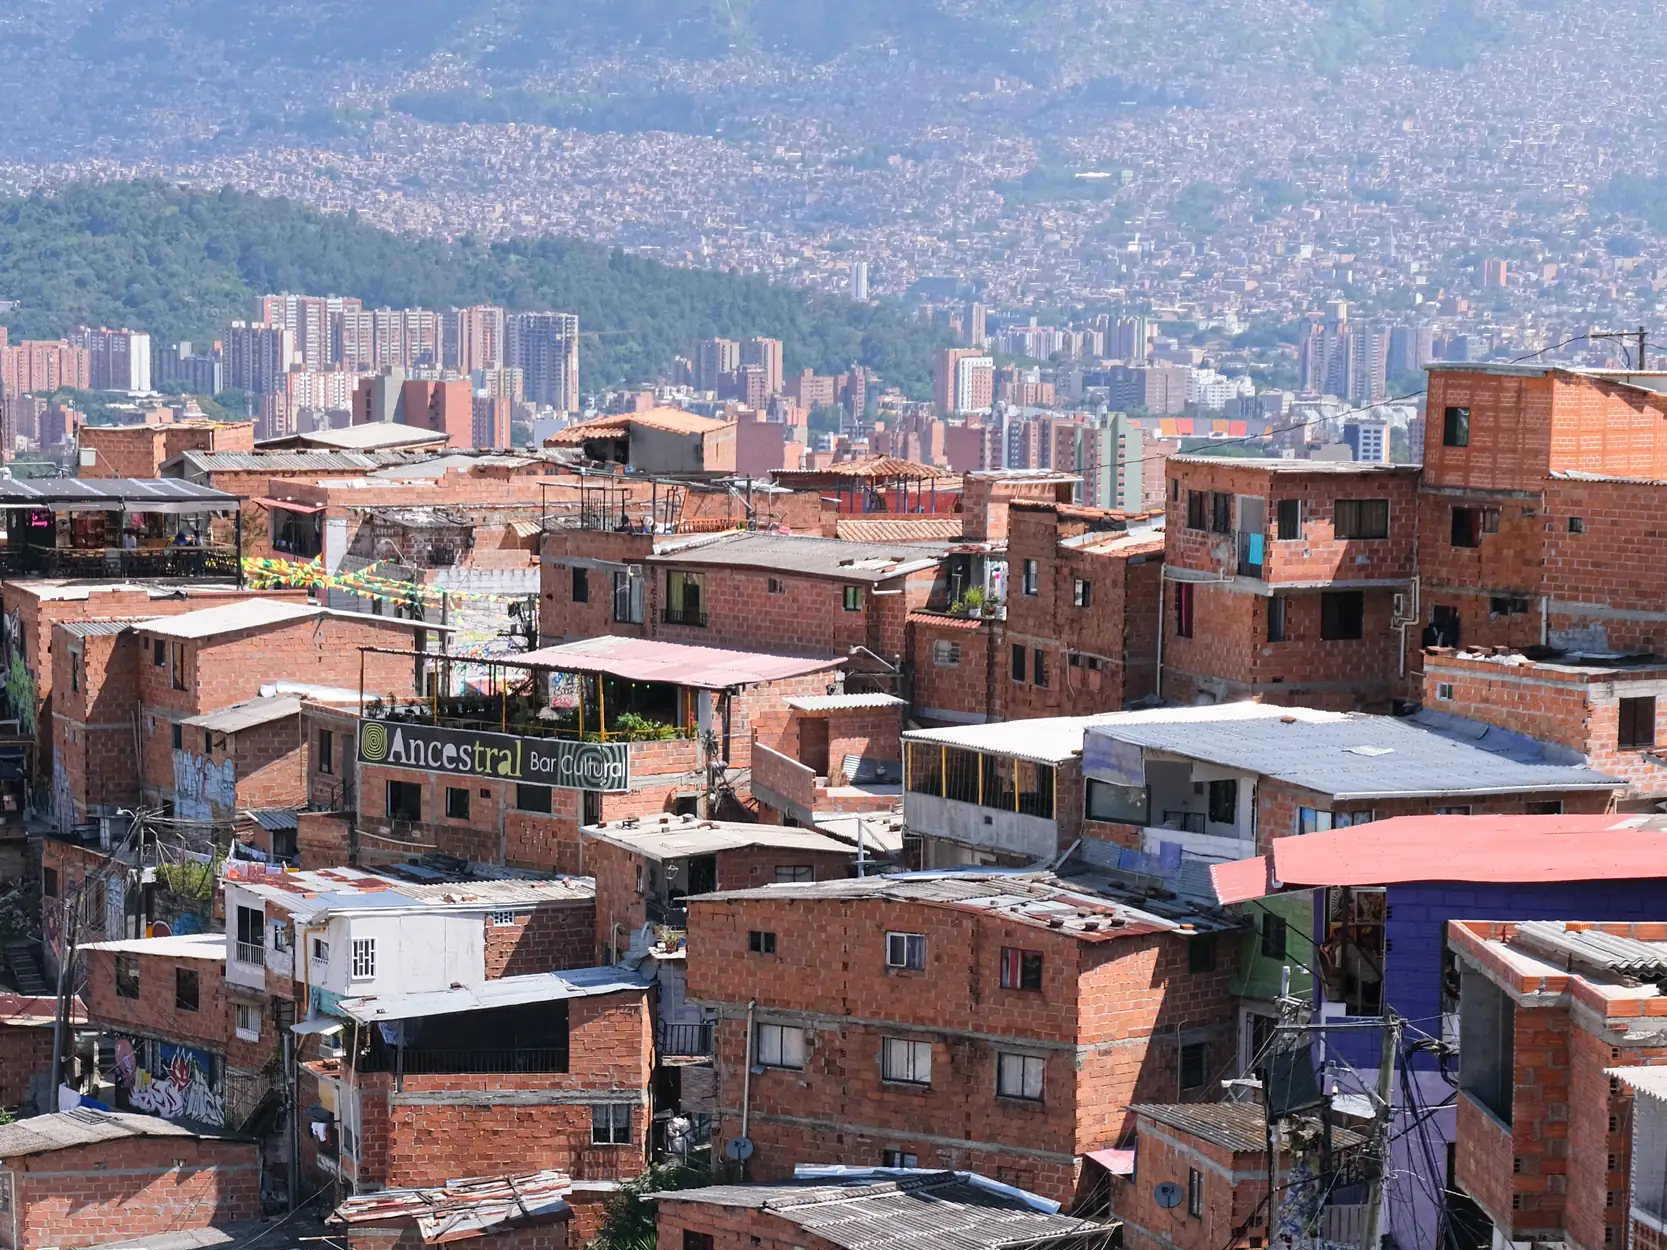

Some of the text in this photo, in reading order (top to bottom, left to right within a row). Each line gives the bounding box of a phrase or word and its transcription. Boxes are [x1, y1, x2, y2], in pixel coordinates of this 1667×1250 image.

[387, 727, 626, 778] Ancestral Bar Cultural
